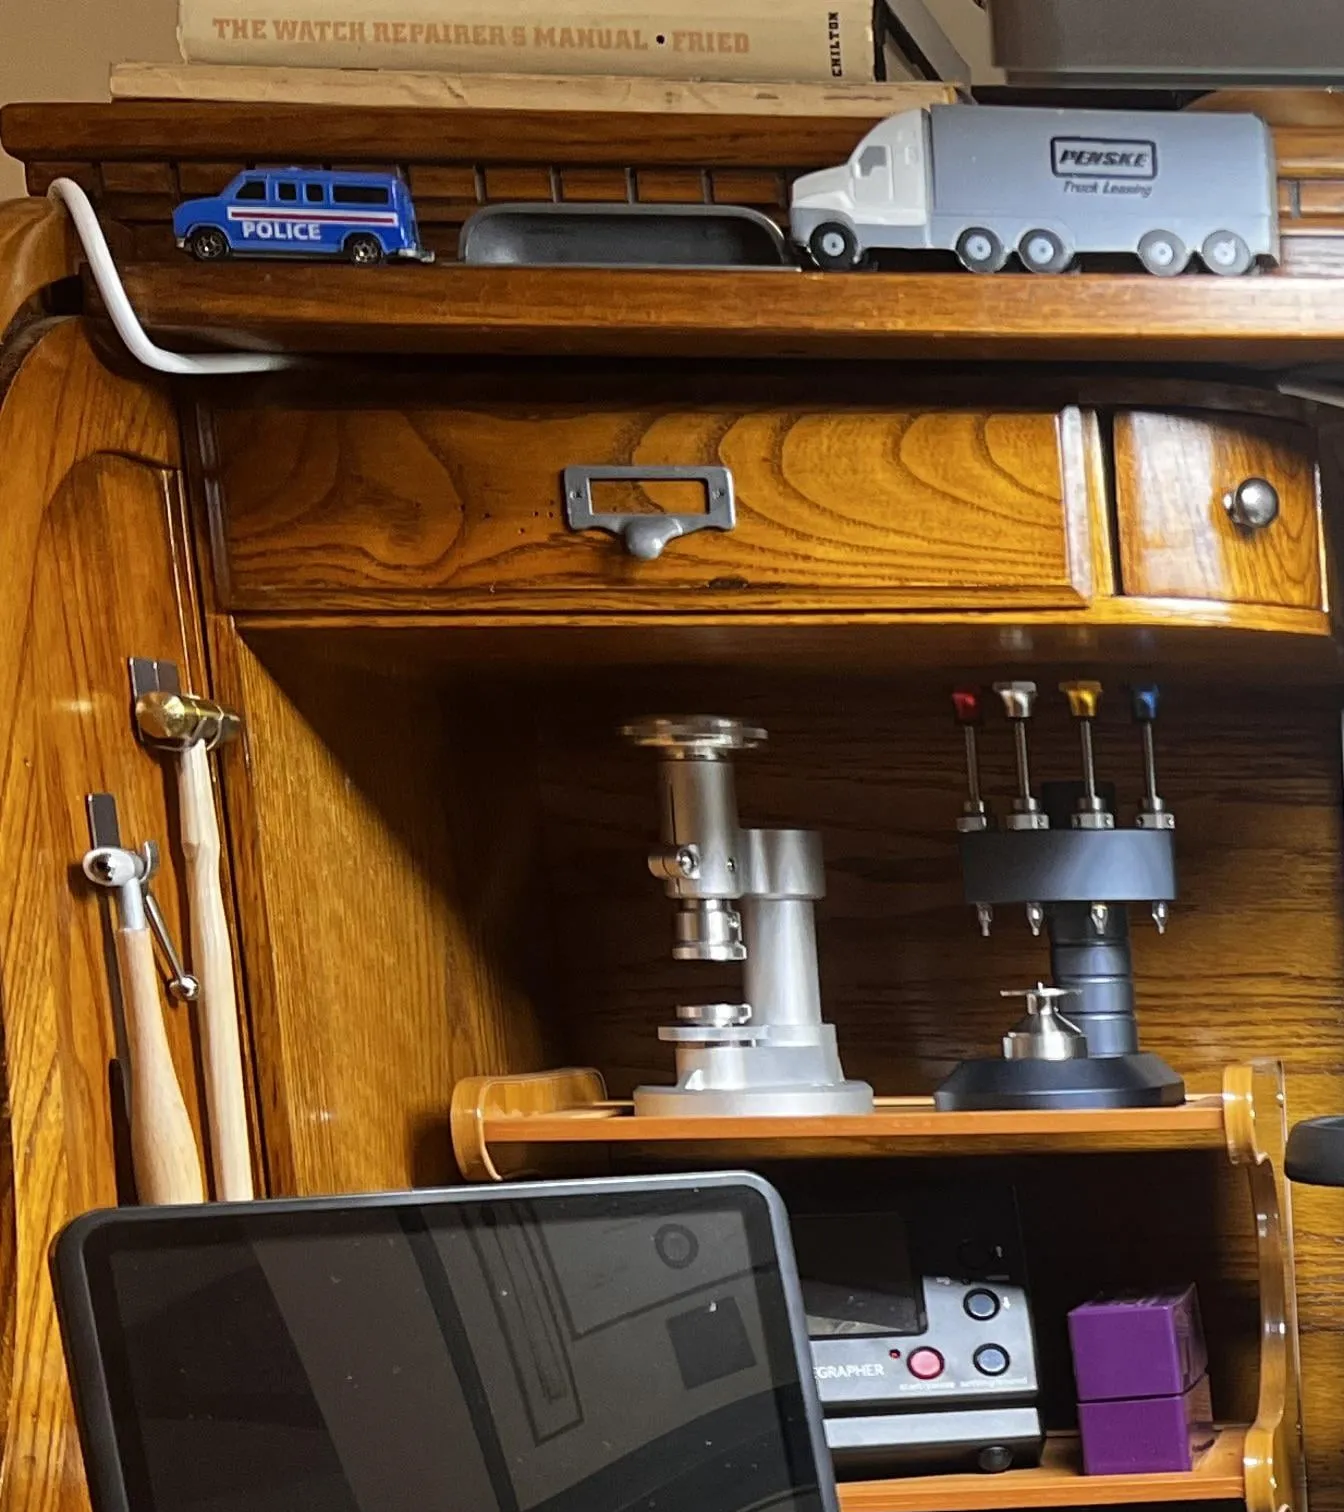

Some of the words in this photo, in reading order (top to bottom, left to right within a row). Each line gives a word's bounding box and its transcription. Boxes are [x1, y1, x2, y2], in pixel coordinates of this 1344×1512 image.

[213, 18, 267, 39] THE
[272, 20, 365, 42] WATCH
[533, 26, 648, 50] MANUAL
[671, 30, 749, 53] FRIED
[828, 12, 843, 77] CHILTON
[1059, 149, 1149, 168] PENSKE
[1102, 180, 1153, 199] Leasing
[242, 220, 321, 241] POLICE
